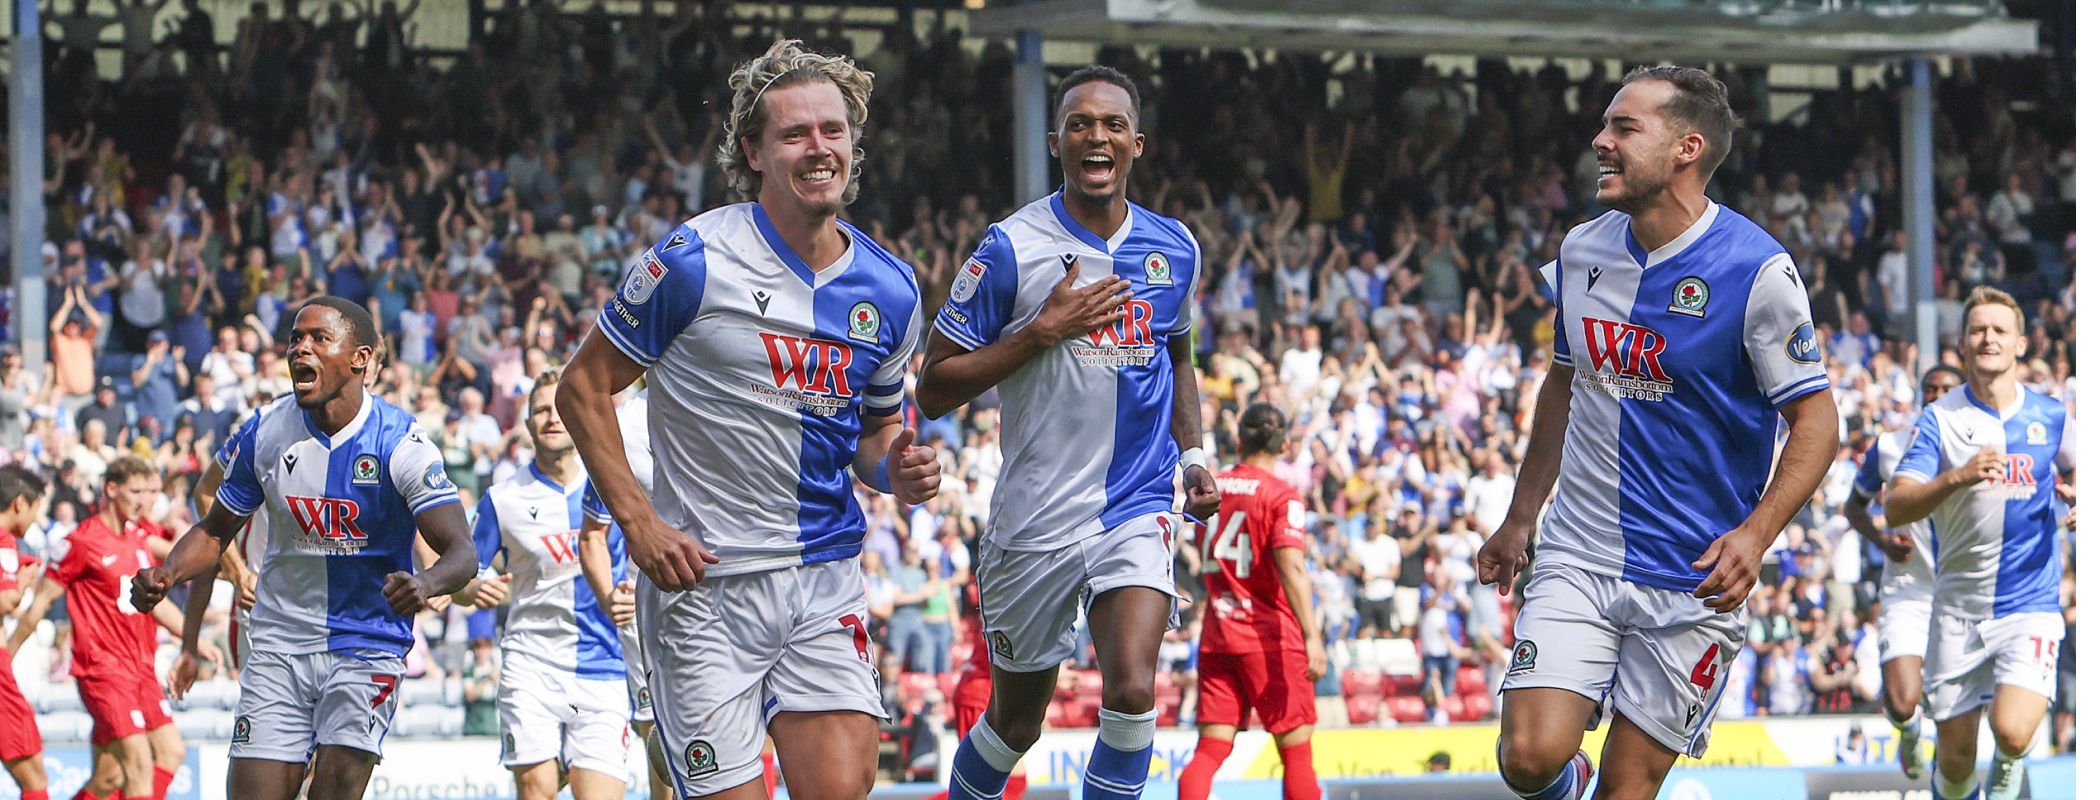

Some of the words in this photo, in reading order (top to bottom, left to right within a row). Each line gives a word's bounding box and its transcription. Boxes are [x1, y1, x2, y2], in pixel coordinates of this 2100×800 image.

[758, 332, 852, 397] WR
[1581, 317, 1673, 383] WR
[750, 384, 848, 407] WatsonRamsbottom
[758, 396, 837, 416] SOLICITORS
[284, 495, 369, 540] WR
[370, 675, 396, 710] 7
[1690, 643, 1719, 701] 4
